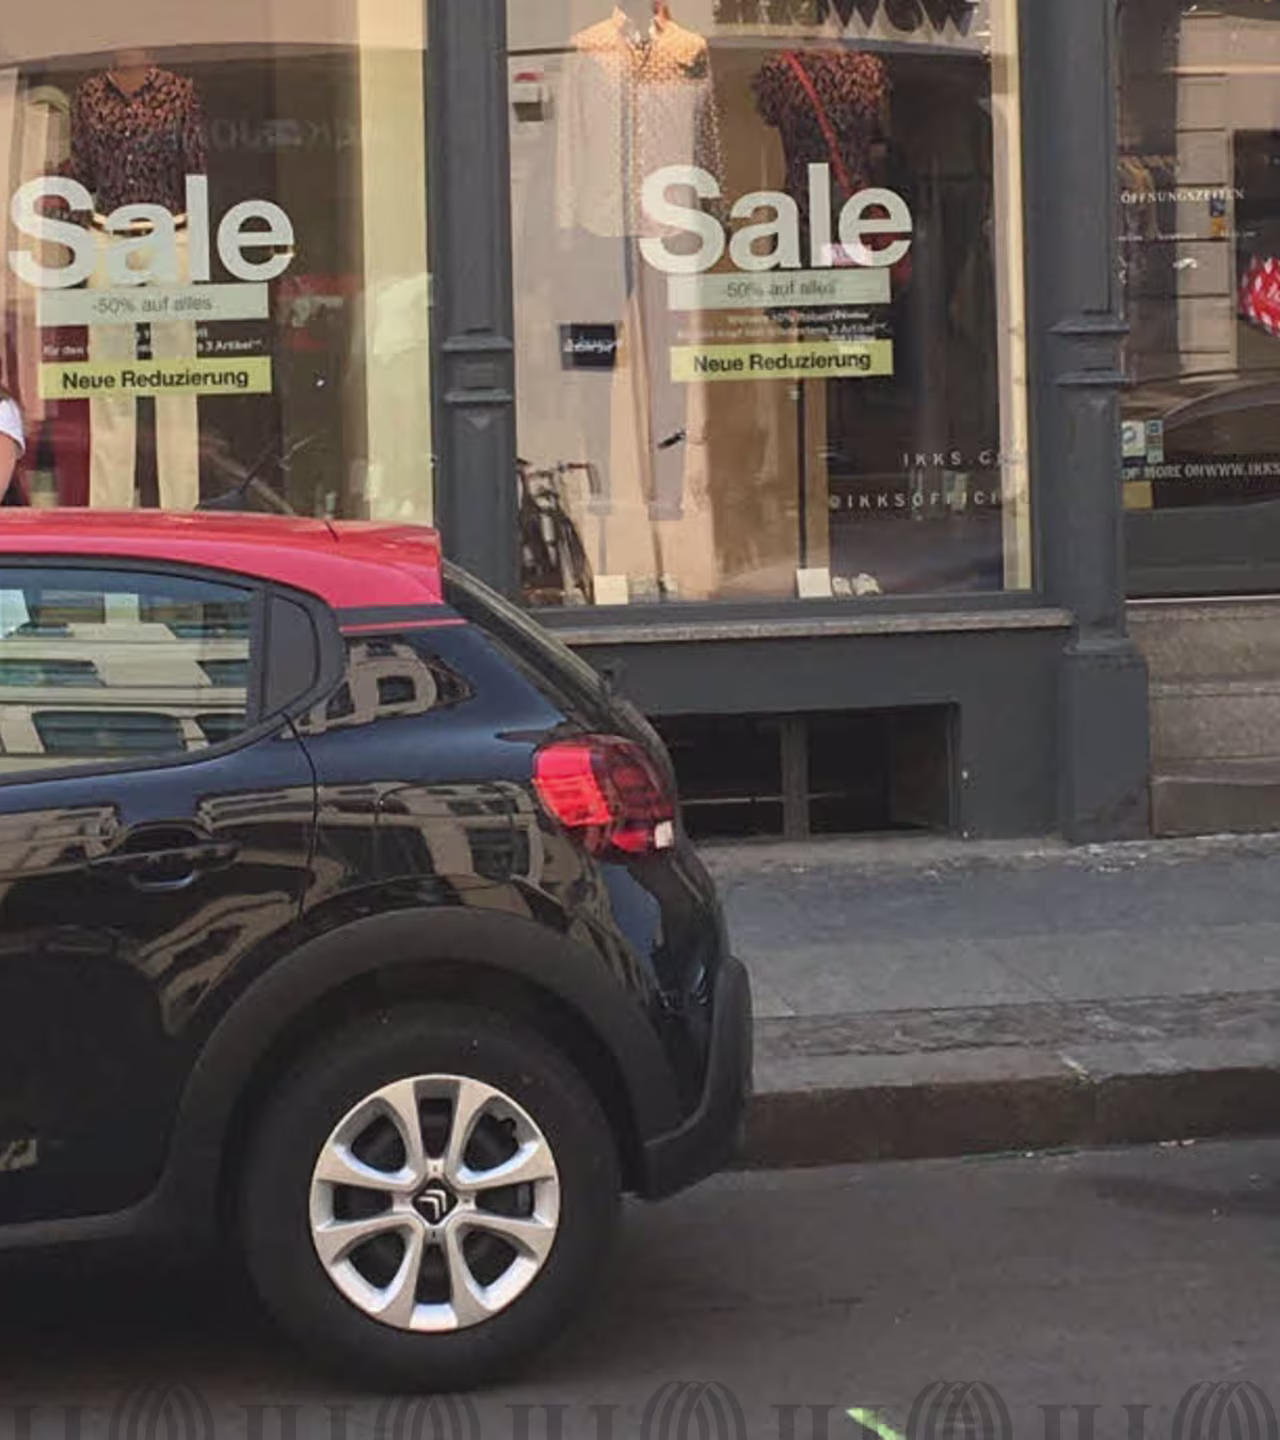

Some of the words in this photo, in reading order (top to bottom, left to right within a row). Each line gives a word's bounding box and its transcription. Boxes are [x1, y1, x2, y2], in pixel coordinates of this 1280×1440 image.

[639, 162, 913, 274] Sale
[8, 173, 294, 290] Sale
[91, 299, 136, 315] -50%
[142, 297, 170, 313] auf
[173, 296, 213, 312] alles
[693, 355, 744, 373] Neue
[749, 351, 872, 373] Reduzierung
[62, 370, 116, 390] Neue
[121, 367, 249, 388] Reduzierung
